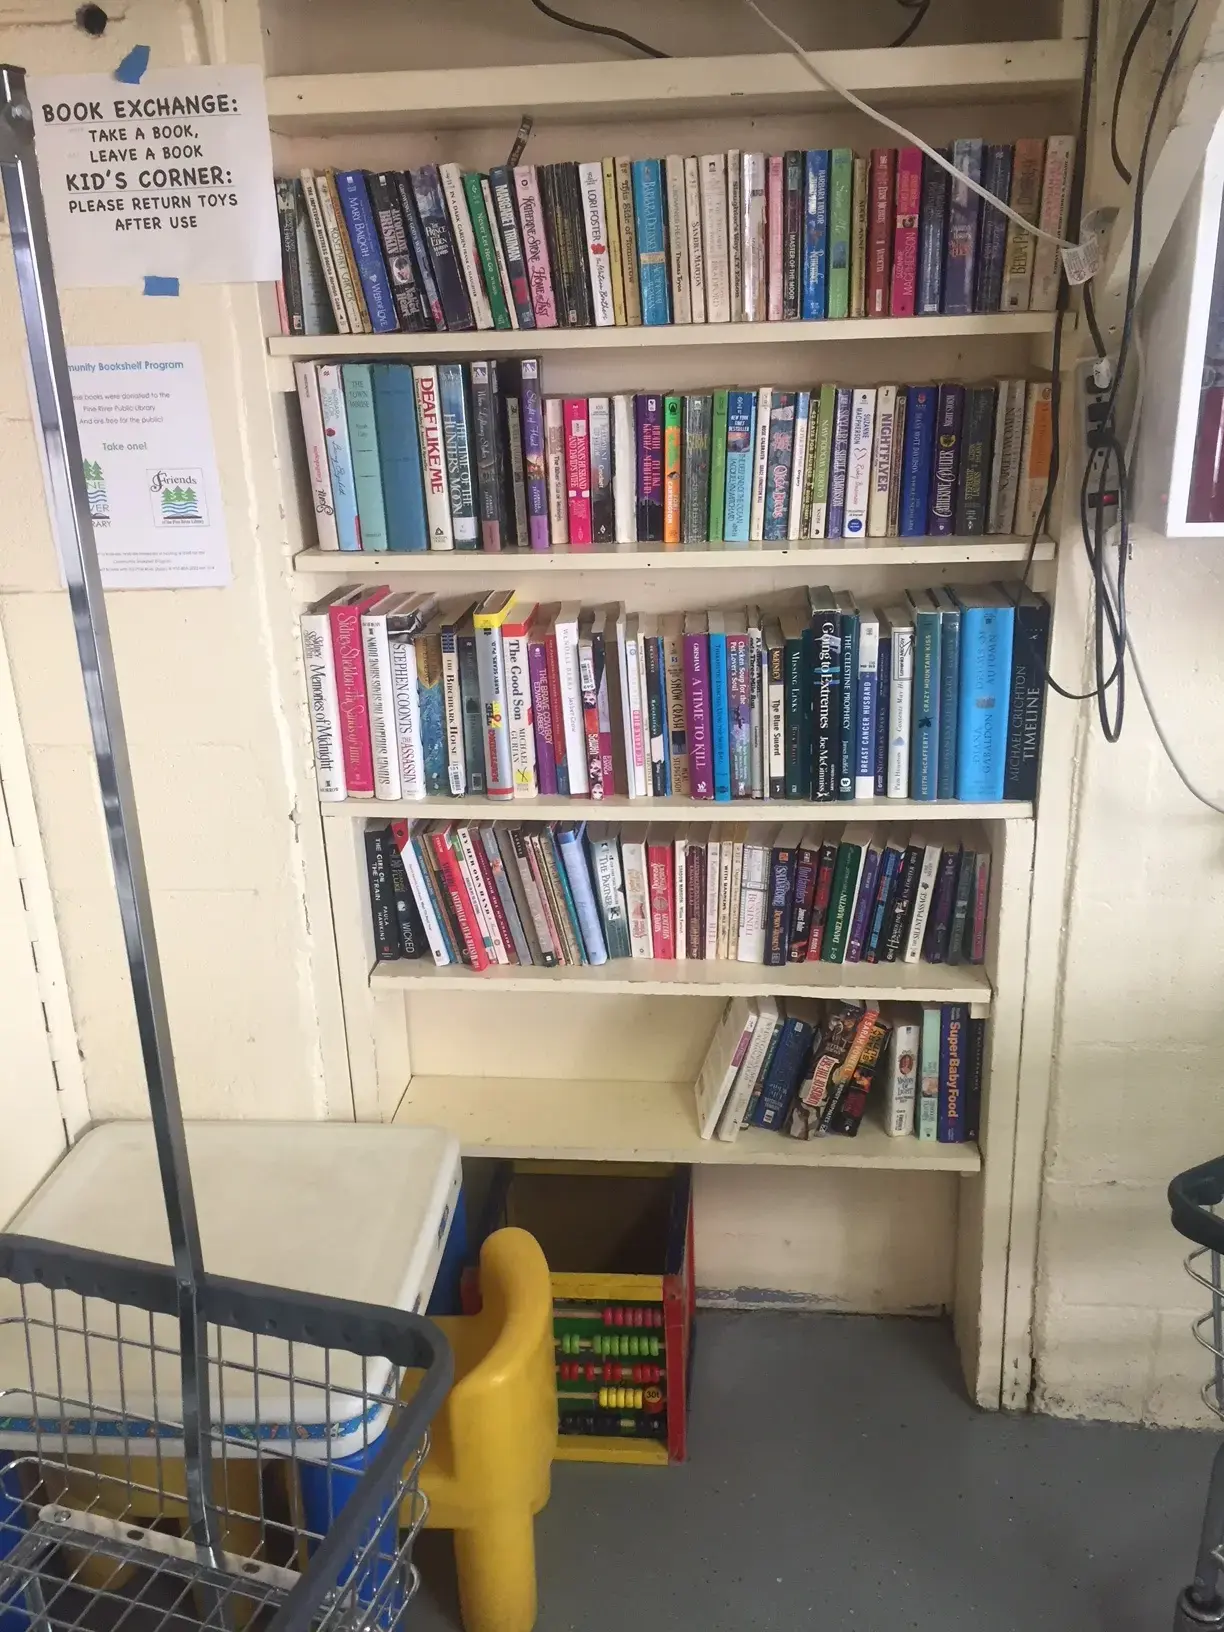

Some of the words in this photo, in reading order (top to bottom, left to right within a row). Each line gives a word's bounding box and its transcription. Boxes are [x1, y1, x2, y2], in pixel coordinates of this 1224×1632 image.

[42, 102, 103, 123] BOOK
[114, 94, 238, 119] EXCHANGE:
[89, 128, 127, 143] TAKE
[135, 128, 145, 140] A
[152, 124, 199, 140] BOOK,
[90, 148, 137, 163] LEAVE
[145, 147, 155, 160] A
[162, 145, 203, 159] BOOK
[66, 169, 128, 191] KID'S
[138, 165, 232, 188] CORNER:
[621, 180, 630, 201] This
[69, 199, 124, 213] PLEASE
[132, 196, 191, 210] RETURN
[198, 194, 238, 207] TOYS
[622, 203, 631, 224] Side
[115, 217, 162, 231] AFTER
[169, 216, 198, 228] USE
[495, 184, 514, 227] MARGARET
[505, 228, 521, 262] TRUMAN
[625, 226, 631, 235] of
[477, 213, 486, 234] Never
[483, 248, 491, 261] Her
[487, 262, 494, 272] Go
[626, 236, 635, 284] Tomorrow
[694, 255, 702, 287] MARTON
[789, 260, 795, 268] OF
[809, 249, 824, 284] Remember
[903, 232, 916, 296] MACPHERSON
[98, 361, 142, 371] Bookshelf
[144, 360, 184, 371] Program
[421, 378, 437, 424] DEAF
[456, 421, 466, 442] THE
[838, 409, 849, 445] SKYLARK
[853, 408, 862, 445] MACPHERSON
[862, 413, 870, 439] SUZANNE
[102, 442, 125, 452] Take
[425, 426, 442, 467] LIKE
[444, 413, 460, 474] HUNTER'S
[568, 436, 576, 448] AND
[819, 420, 828, 466] WOODLAWN
[877, 414, 892, 492] NIGHTFLYER
[458, 445, 469, 468] TIME
[570, 450, 578, 471] DAVID'S
[834, 450, 845, 473] SHEILA
[431, 468, 444, 494] ME
[461, 472, 470, 486] OF
[775, 465, 788, 490] OLGA
[817, 468, 827, 499] CADDIE
[832, 474, 844, 507] SIMONSON
[450, 477, 463, 514] MOON
[462, 487, 472, 506] THE
[508, 640, 520, 659] The
[821, 622, 834, 660] Going
[693, 643, 701, 672] GRISHAM
[820, 662, 831, 673] to
[309, 664, 328, 711] Memories
[511, 661, 523, 696] Good
[539, 669, 547, 684] THE
[670, 678, 680, 701] SNOW
[692, 678, 701, 686] A
[514, 699, 524, 720] Son
[533, 681, 541, 711] EDWARD
[540, 685, 549, 711] BRAVE
[692, 689, 703, 721] TIME
[819, 674, 833, 729] Extremes
[862, 682, 871, 715] HUSBAND
[1014, 666, 1026, 727] CRICHTON
[314, 713, 328, 725] of
[535, 712, 544, 736] ABBEY
[672, 704, 684, 729] CRASH
[843, 692, 851, 730] PROPHECY
[1023, 688, 1040, 762] TIMELINE
[542, 712, 552, 744] COWBOY
[694, 724, 704, 740] TO
[862, 718, 870, 745] CANCER
[317, 725, 334, 772] Midnight
[510, 730, 519, 763] GURIAN
[518, 728, 528, 765] MICHAEL
[589, 734, 600, 755] VAMPS
[689, 743, 706, 770] KILL
[819, 736, 829, 749] Joe
[1009, 732, 1022, 781] MICHAEL
[818, 749, 828, 792] McGinniss
[861, 747, 869, 773] BREAST
[379, 872, 385, 882] ON
[462, 833, 468, 844] BY
[466, 848, 474, 866] HER
[473, 870, 481, 887] OWN
[480, 891, 490, 914] HAND
[599, 855, 609, 873] THE
[601, 874, 613, 906] PARTNER
[377, 912, 385, 941] HAWKINS
[746, 893, 757, 936] BUSHNELL
[832, 921, 840, 943] DANIEL
[836, 894, 847, 918] MARTIN
[402, 922, 414, 953] WICKED
[810, 937, 818, 953] RIDDLE
[857, 1020, 870, 1044] SARAH
[948, 1022, 960, 1057] Super
[844, 1045, 863, 1072] VOWELL
[947, 1058, 960, 1088] Baby
[948, 1089, 958, 1117] Food
